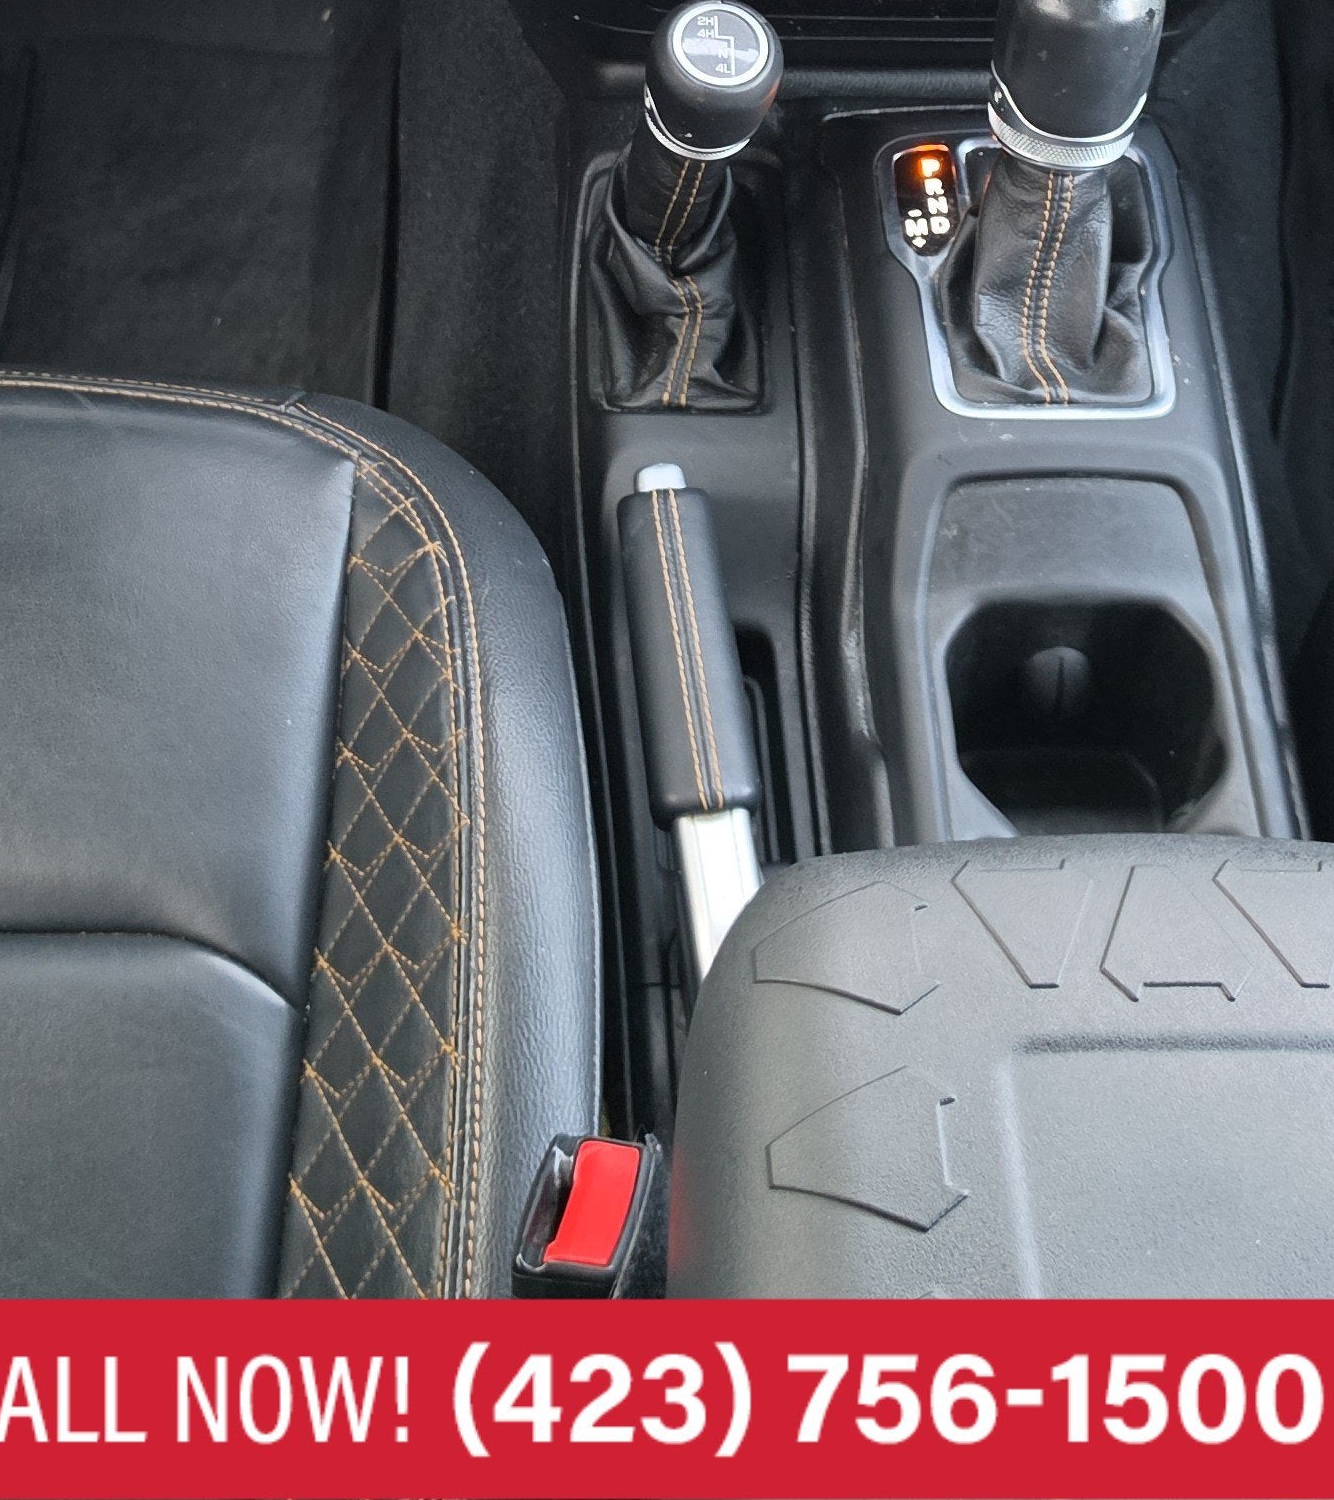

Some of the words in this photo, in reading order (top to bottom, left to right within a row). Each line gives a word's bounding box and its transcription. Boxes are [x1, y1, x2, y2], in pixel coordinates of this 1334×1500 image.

[696, 16, 715, 27] 2H
[696, 28, 716, 38] 4H
[715, 63, 731, 75] 4L
[920, 158, 941, 178] P
[924, 177, 945, 196] R
[927, 195, 949, 215] N
[929, 215, 951, 235] D
